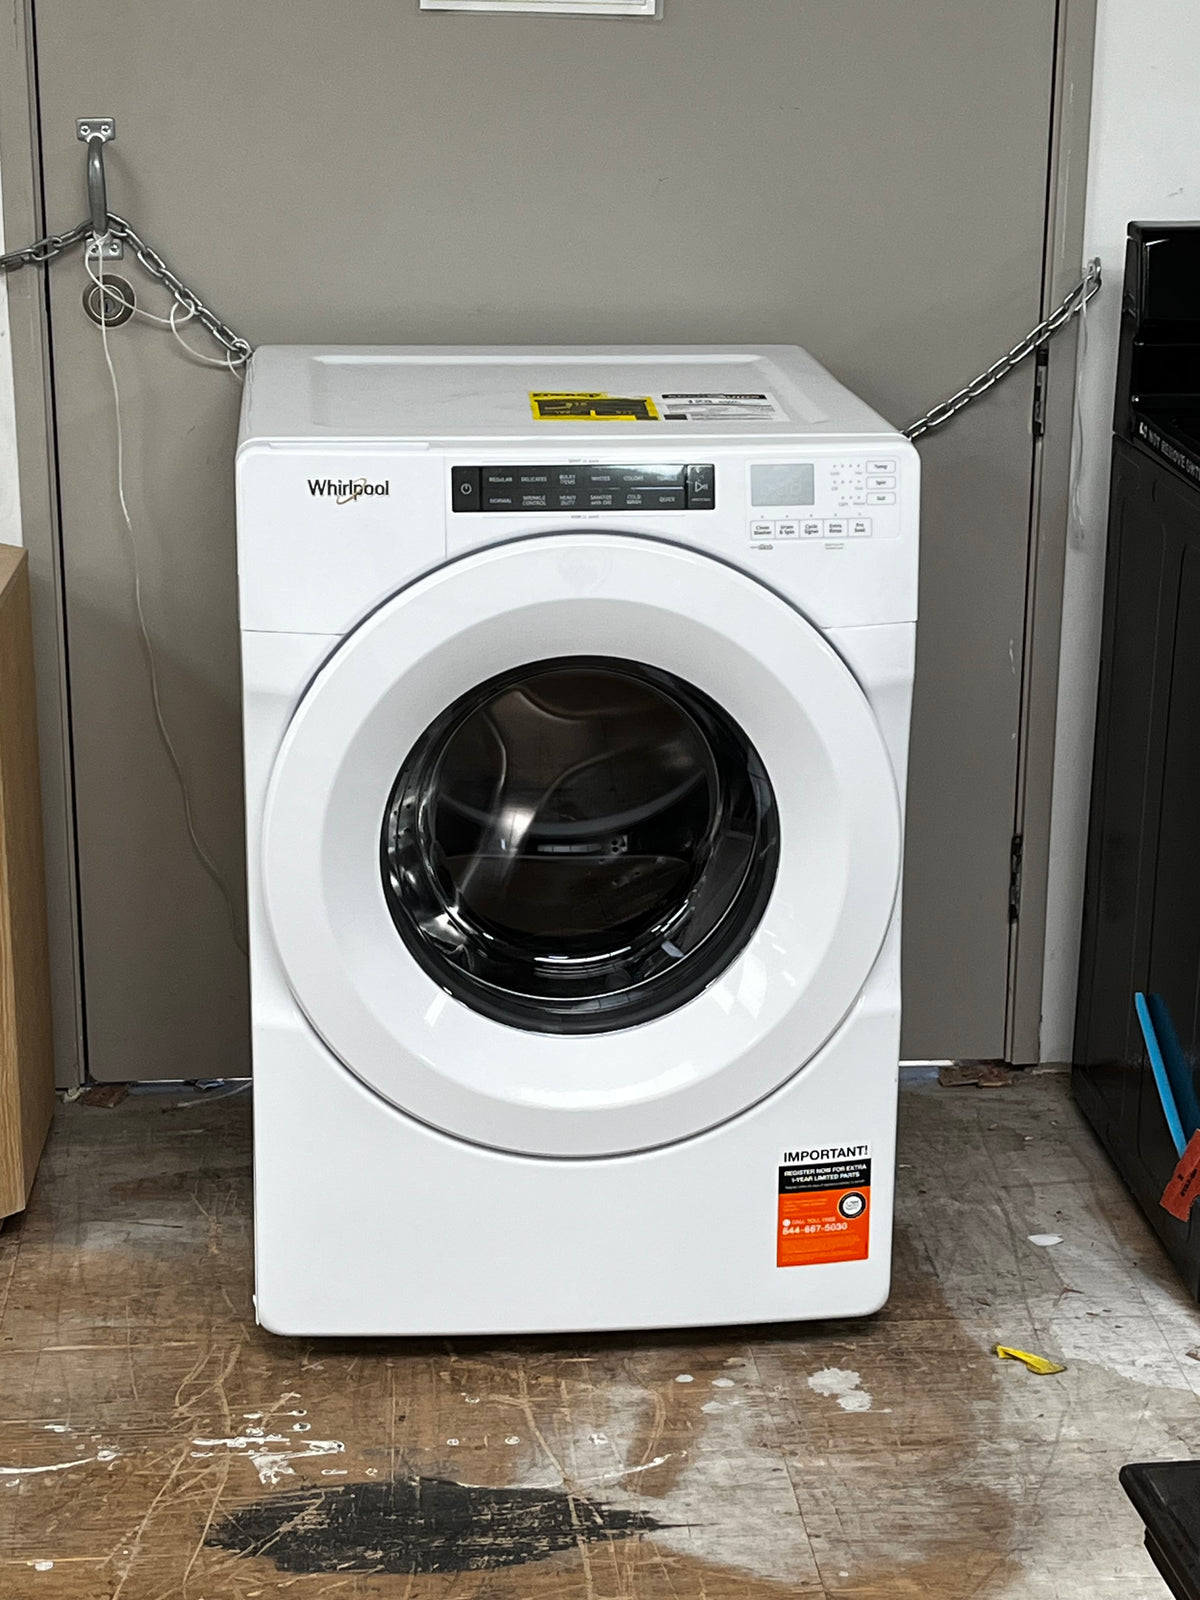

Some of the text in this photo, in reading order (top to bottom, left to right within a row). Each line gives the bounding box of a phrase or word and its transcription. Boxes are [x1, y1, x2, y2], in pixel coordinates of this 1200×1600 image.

[307, 479, 389, 501] Whirlpool
[783, 1145, 868, 1163] IMPORTANT!
[784, 1163, 867, 1177] REGISTER NOW FOR EXTRA
[814, 1173, 840, 1182] LIMITED
[840, 1171, 860, 1180] PARTS
